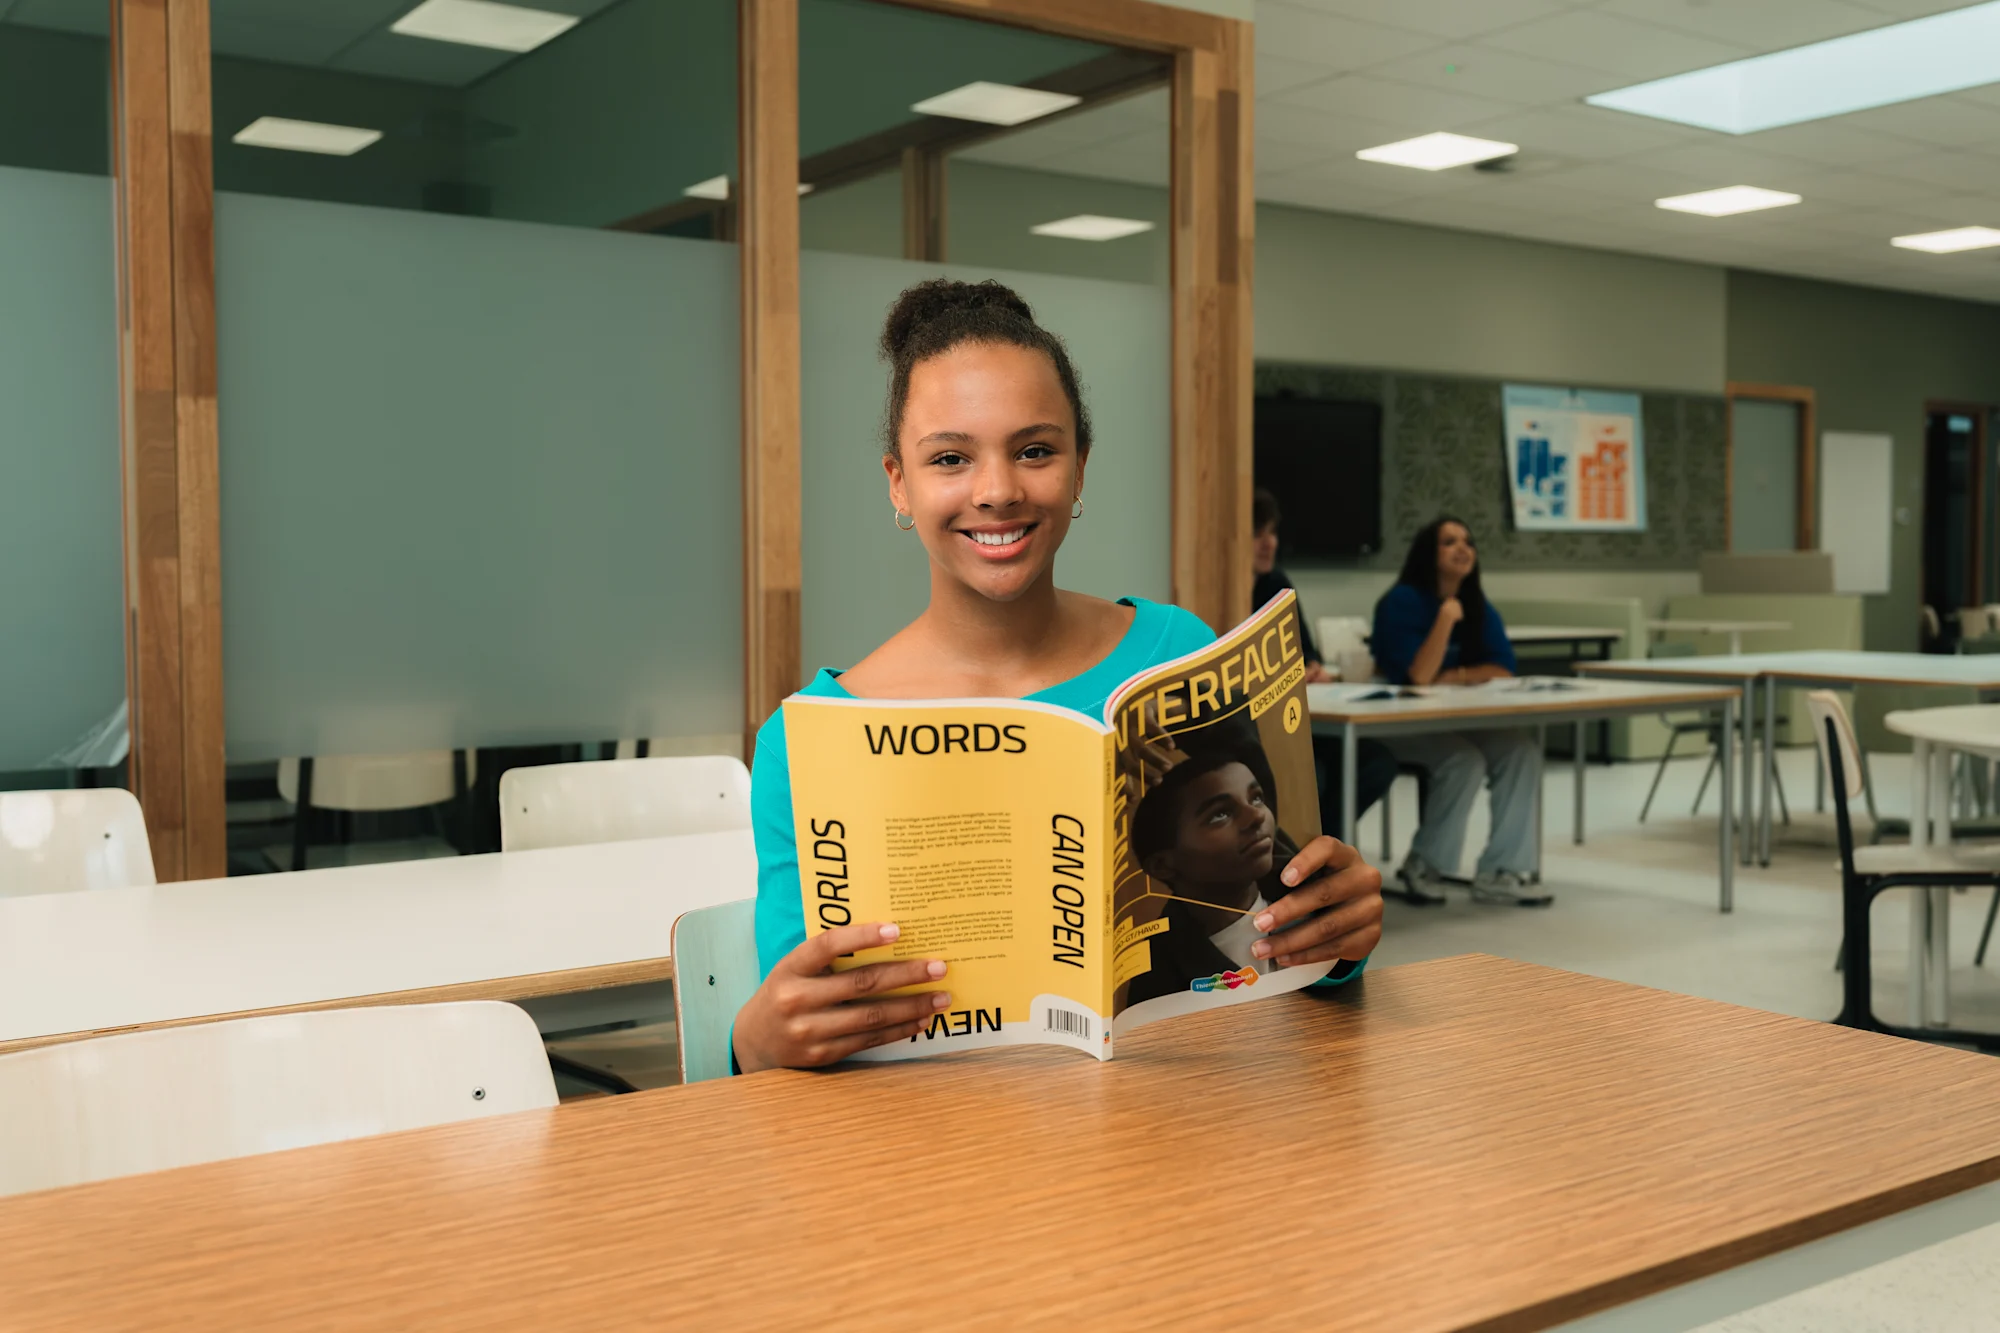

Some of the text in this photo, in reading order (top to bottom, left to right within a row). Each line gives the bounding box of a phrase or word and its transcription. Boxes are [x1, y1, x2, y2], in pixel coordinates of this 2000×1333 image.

[1253, 663, 1302, 713] OPEN WORLDS
[1289, 706, 1297, 726] A
[864, 723, 1027, 755] WORDS
[811, 818, 854, 958] ORLDS
[1052, 813, 1085, 969] CAN OPEN
[1195, 973, 1254, 989] ThiemeMeulenhoff
